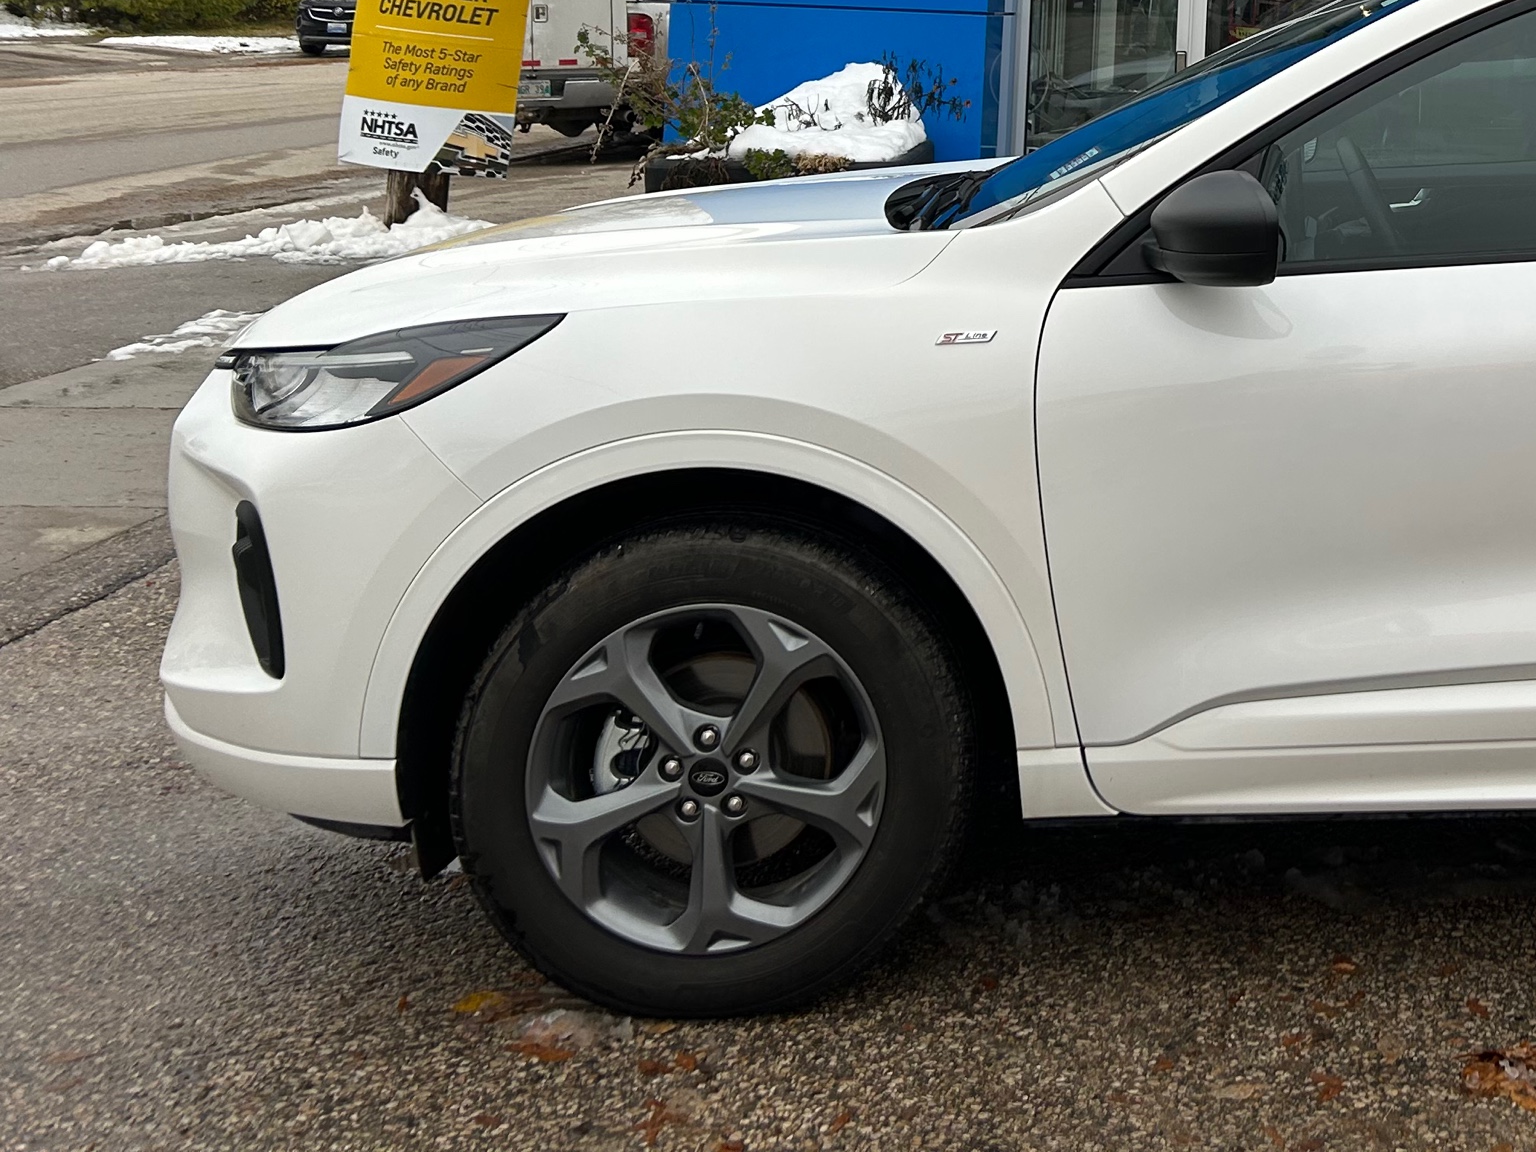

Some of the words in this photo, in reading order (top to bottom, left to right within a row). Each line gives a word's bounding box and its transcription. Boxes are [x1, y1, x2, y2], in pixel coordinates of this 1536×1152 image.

[383, 41, 402, 55] The
[404, 44, 436, 59] Most
[438, 48, 482, 63] 5-Star
[383, 57, 422, 75] Safety
[424, 62, 474, 81] Ratings
[386, 74, 400, 88] of
[400, 77, 424, 91] any
[425, 78, 467, 93] Brand
[361, 116, 418, 139] NHTSA
[372, 146, 399, 159] Safety
[941, 332, 964, 343] ST
[694, 772, 722, 784] Ford
